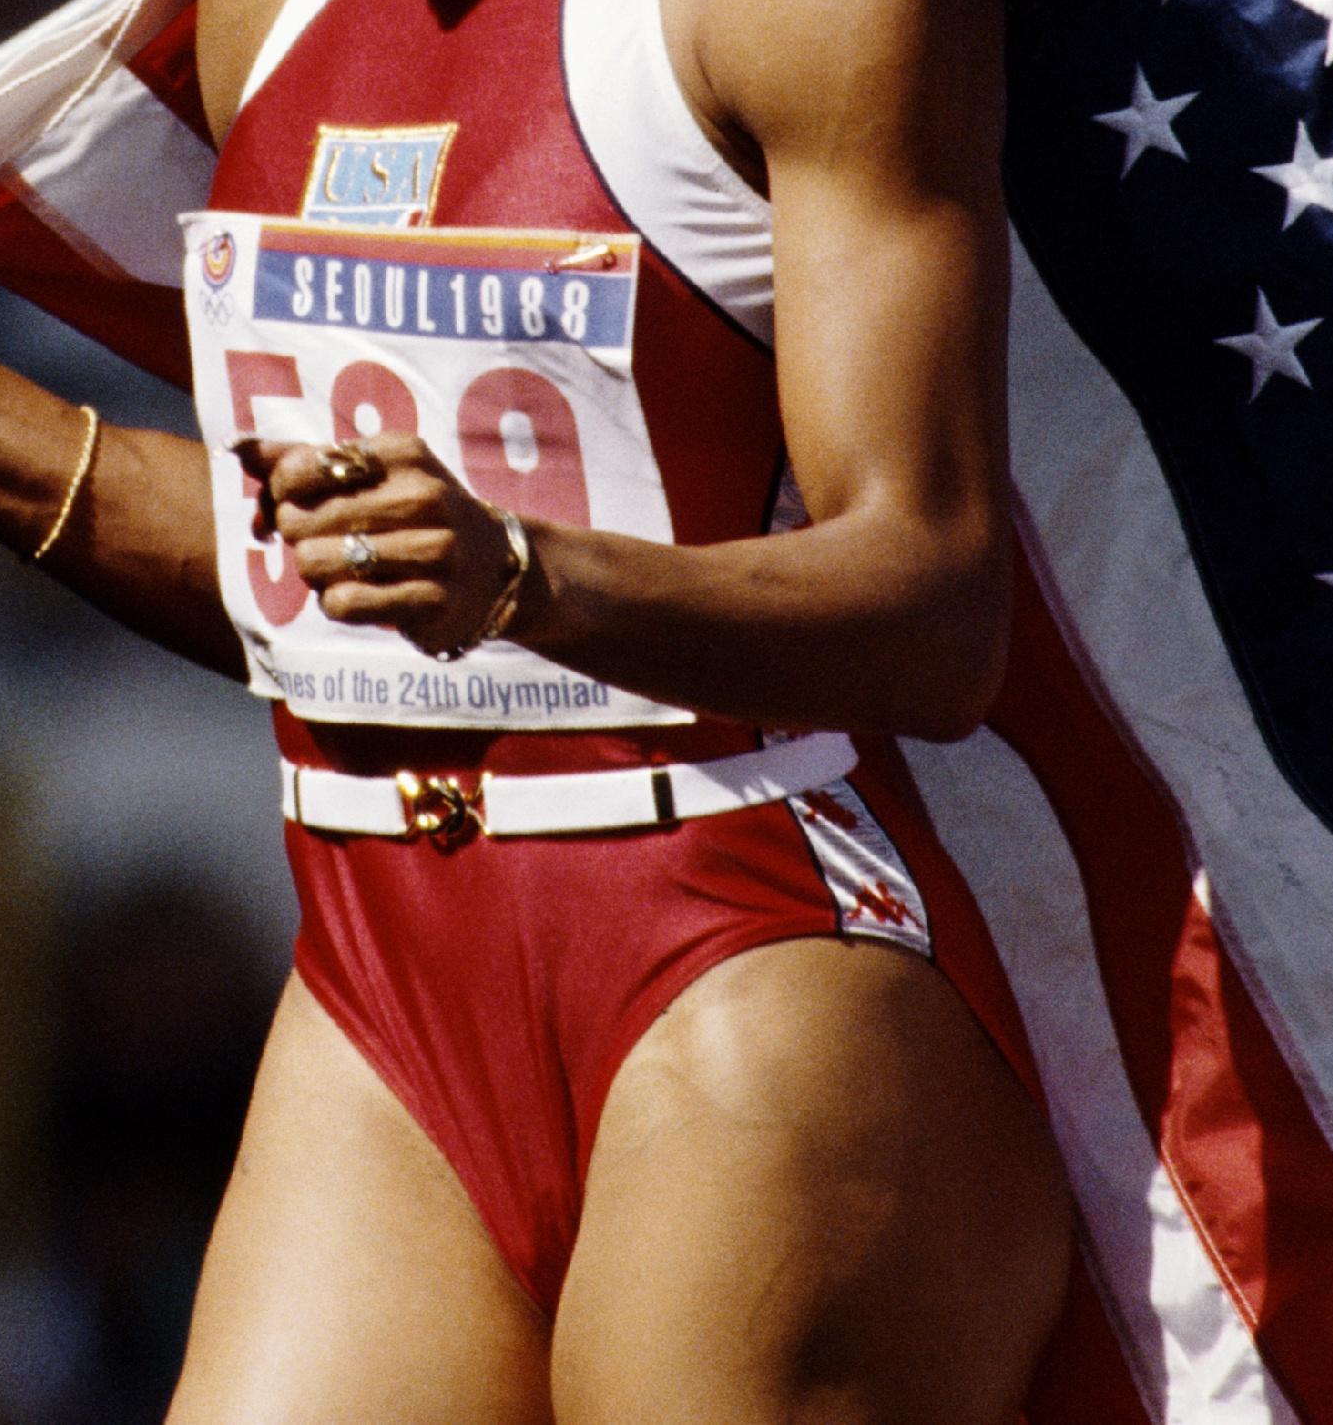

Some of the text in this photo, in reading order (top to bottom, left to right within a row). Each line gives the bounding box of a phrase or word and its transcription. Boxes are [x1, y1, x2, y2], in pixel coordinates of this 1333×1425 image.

[324, 144, 424, 203] USA
[324, 667, 345, 703] of
[352, 669, 389, 705] the
[398, 672, 461, 709] 24th
[467, 673, 609, 716] Olympiad
